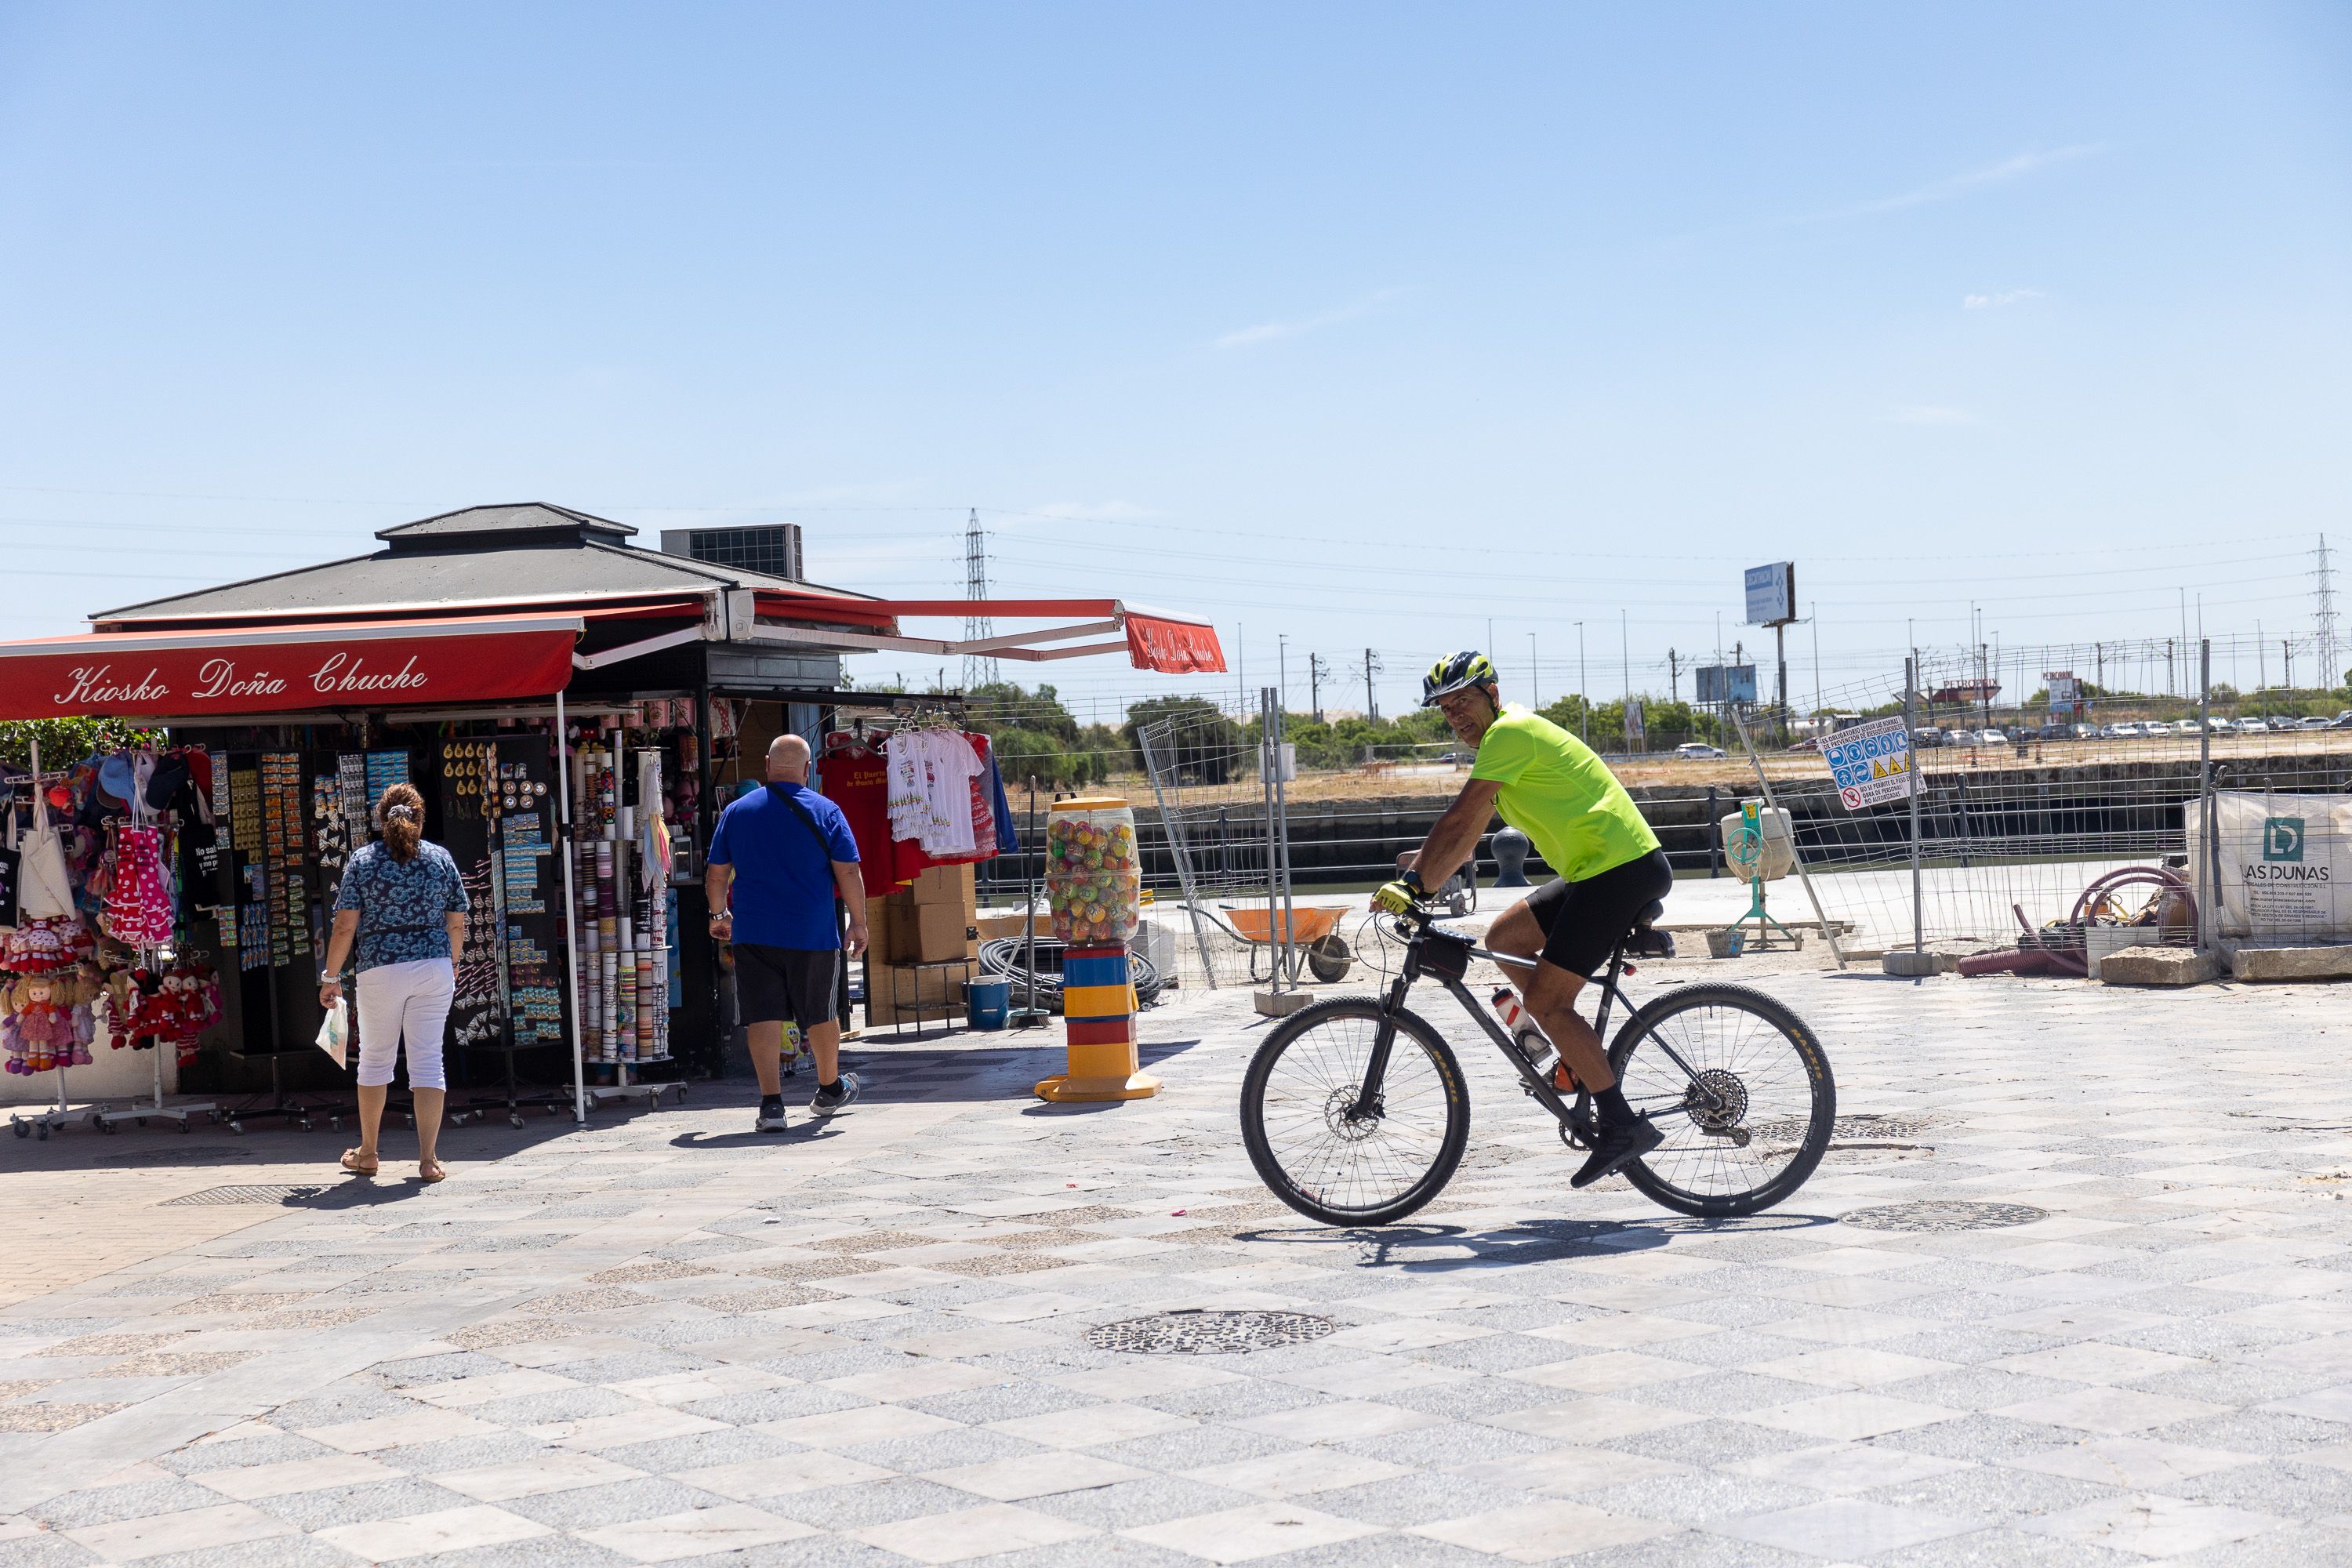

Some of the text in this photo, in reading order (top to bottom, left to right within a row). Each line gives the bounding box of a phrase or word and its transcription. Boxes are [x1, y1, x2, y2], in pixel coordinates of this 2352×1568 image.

[53, 652, 428, 704] Kiosko Doña Chuche
[1944, 677, 1998, 689] PETROPRIX
[1829, 728, 1860, 742] OBLIGATORIO
[1860, 724, 1876, 733] SEGUIR
[1883, 718, 1899, 727] NORMAS
[1867, 729, 1883, 739] RIESGOS
[1883, 724, 1903, 734] LABORALES
[863, 770, 886, 781] Puerto
[875, 777, 887, 786] Mar
[1874, 780, 1890, 789] PERMITE
[1862, 789, 1875, 799] OBRA
[1881, 785, 1903, 795] PERSONAS
[1864, 792, 1901, 805] NO AUTORIZADAS
[195, 848, 205, 857] No
[2270, 866, 2329, 881] DUNAS
[1623, 1053, 1630, 1064] DT
[1789, 1028, 1823, 1080] MAXXIS
[1432, 1048, 1458, 1103] MAXXIS
[1802, 1121, 1817, 1152] DT SWISS
